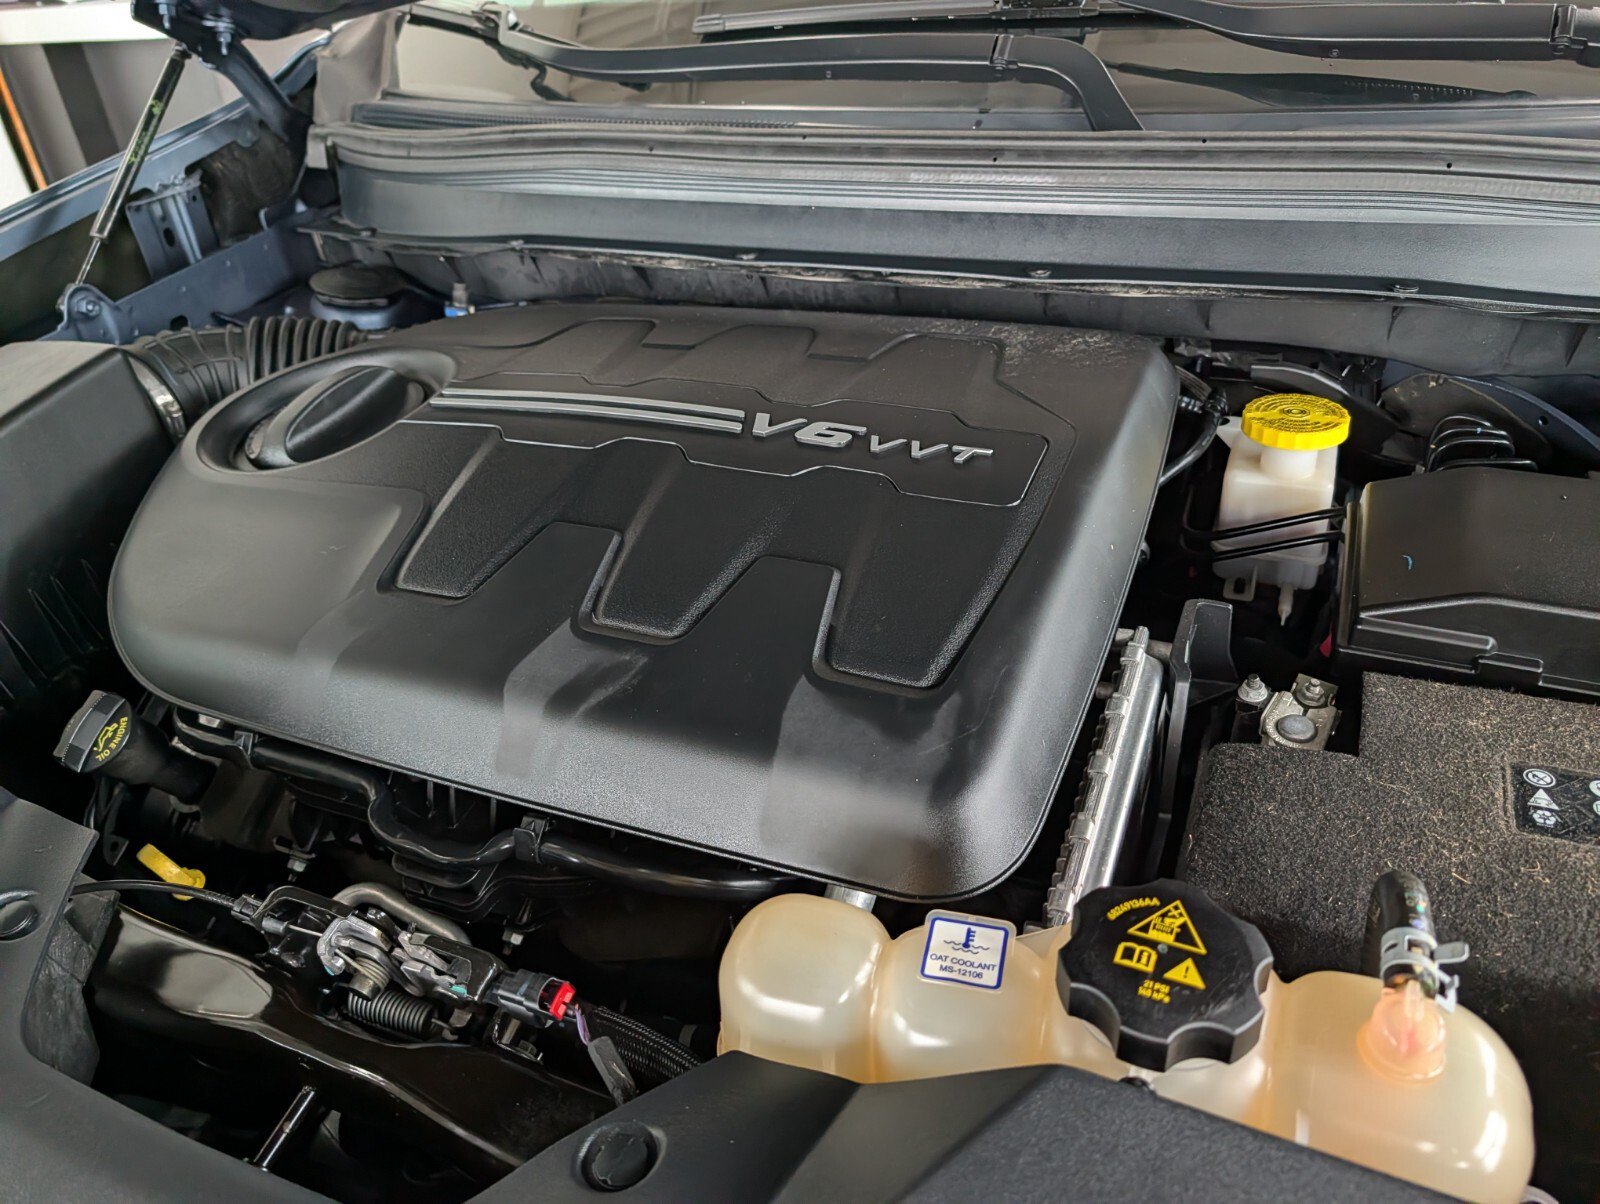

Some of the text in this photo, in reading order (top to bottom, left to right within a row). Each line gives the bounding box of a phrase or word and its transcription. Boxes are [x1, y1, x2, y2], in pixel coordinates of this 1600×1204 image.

[752, 412, 993, 464] V6 VVT
[95, 716, 128, 761] ENGINE OIL
[930, 953, 997, 971] OAT COOLANT
[939, 964, 983, 979] MS-12106
[1153, 982, 1170, 994] PSI
